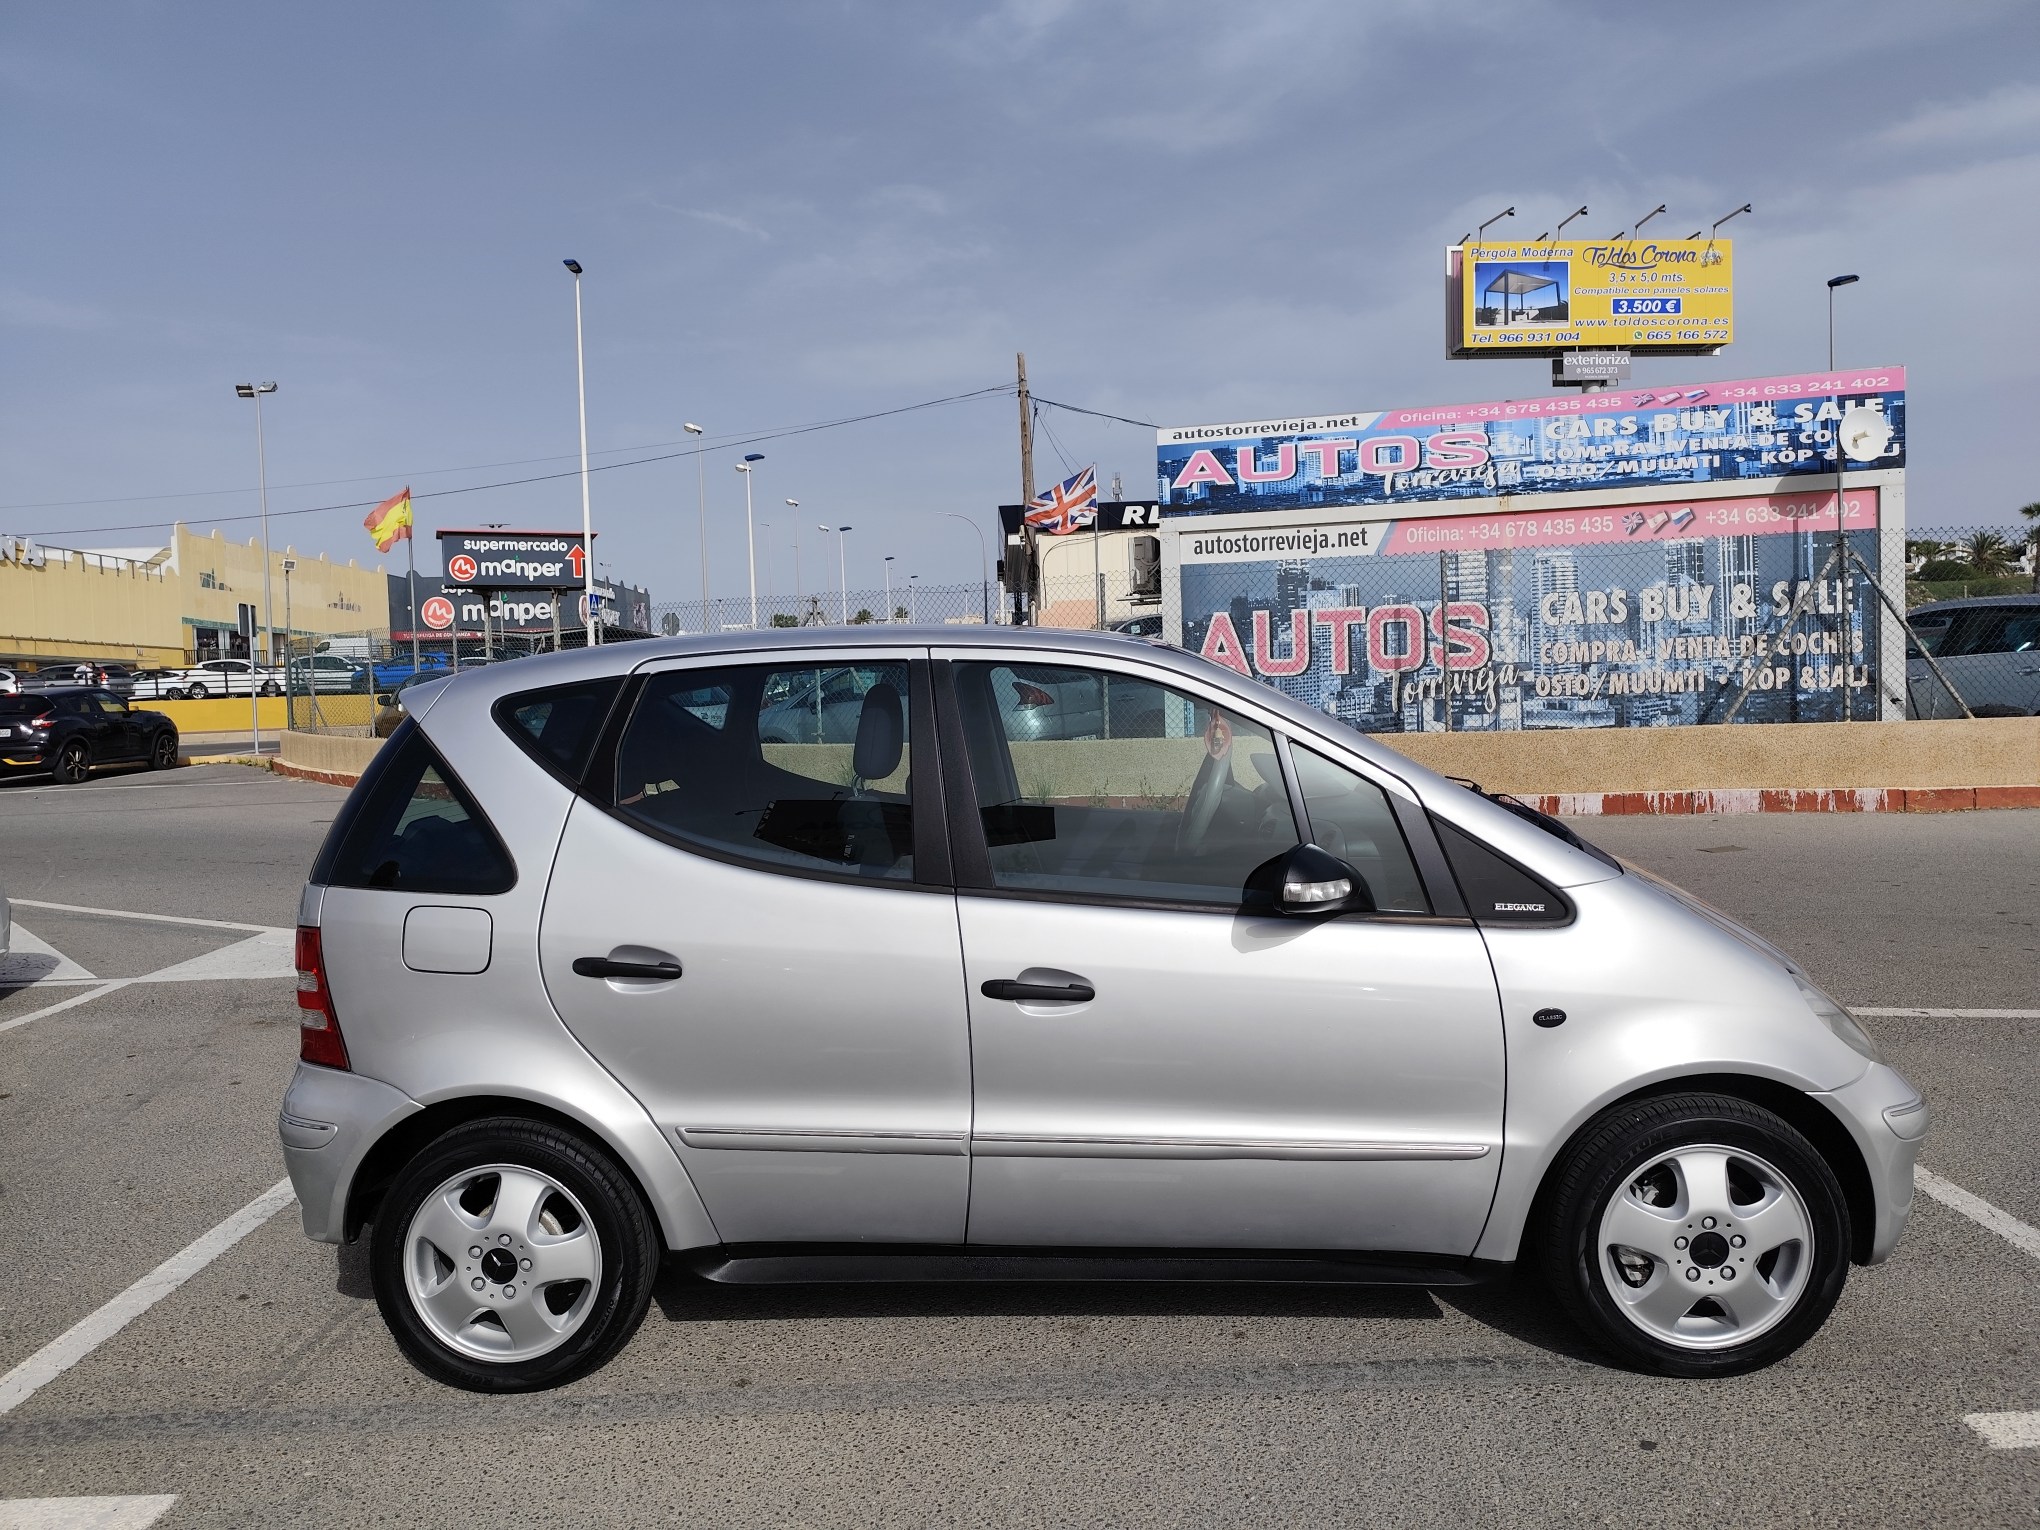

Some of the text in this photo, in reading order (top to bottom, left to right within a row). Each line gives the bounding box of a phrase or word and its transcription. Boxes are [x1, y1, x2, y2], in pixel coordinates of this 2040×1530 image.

[1521, 247, 1573, 257] Moderna
[1641, 245, 1697, 264] Corona
[1609, 272, 1626, 283] 3,5
[1640, 272, 1658, 283] 5,0
[1661, 272, 1686, 282] mts.
[1574, 287, 1630, 295] Compatible
[1653, 286, 1691, 295] paneles
[1618, 300, 1661, 313] 3.500
[1575, 317, 1729, 327] www.toldoscorona.es
[1471, 332, 1580, 343] Tel. 966 931 004
[1646, 330, 1728, 340] 665 166 572
[1564, 354, 1630, 366] exterioriza
[1721, 377, 1889, 399] +34 633 241 402
[1400, 397, 1622, 423] Oficina: +34 678 435 435
[1173, 416, 1359, 440] autostorrevieja.net
[1546, 415, 1638, 440] CARS
[1654, 409, 1734, 433] BUY
[1749, 406, 1778, 426] &
[1543, 442, 1649, 462] COMPRA
[1671, 435, 1750, 453] VENTA
[1758, 433, 1789, 447] DE
[1170, 431, 1491, 489] AUTOS
[1706, 507, 1740, 525] +34
[1745, 506, 1780, 523] 633
[1786, 503, 1820, 521] 241
[1406, 515, 1614, 543] Oficina: +34 678 435 435
[463, 538, 568, 553] supermercado
[1193, 527, 1368, 554] autostorrevieja.net
[480, 558, 563, 581] manper
[1541, 589, 1628, 626] CARS
[1641, 584, 1715, 622] BUY
[1730, 583, 1758, 618] &
[1200, 601, 1492, 678] AUTOS
[1540, 639, 1637, 664] COMPRA
[1659, 636, 1732, 660] VENTA
[1740, 634, 1768, 657] DE
[1494, 902, 1546, 911] ELEGANCE
